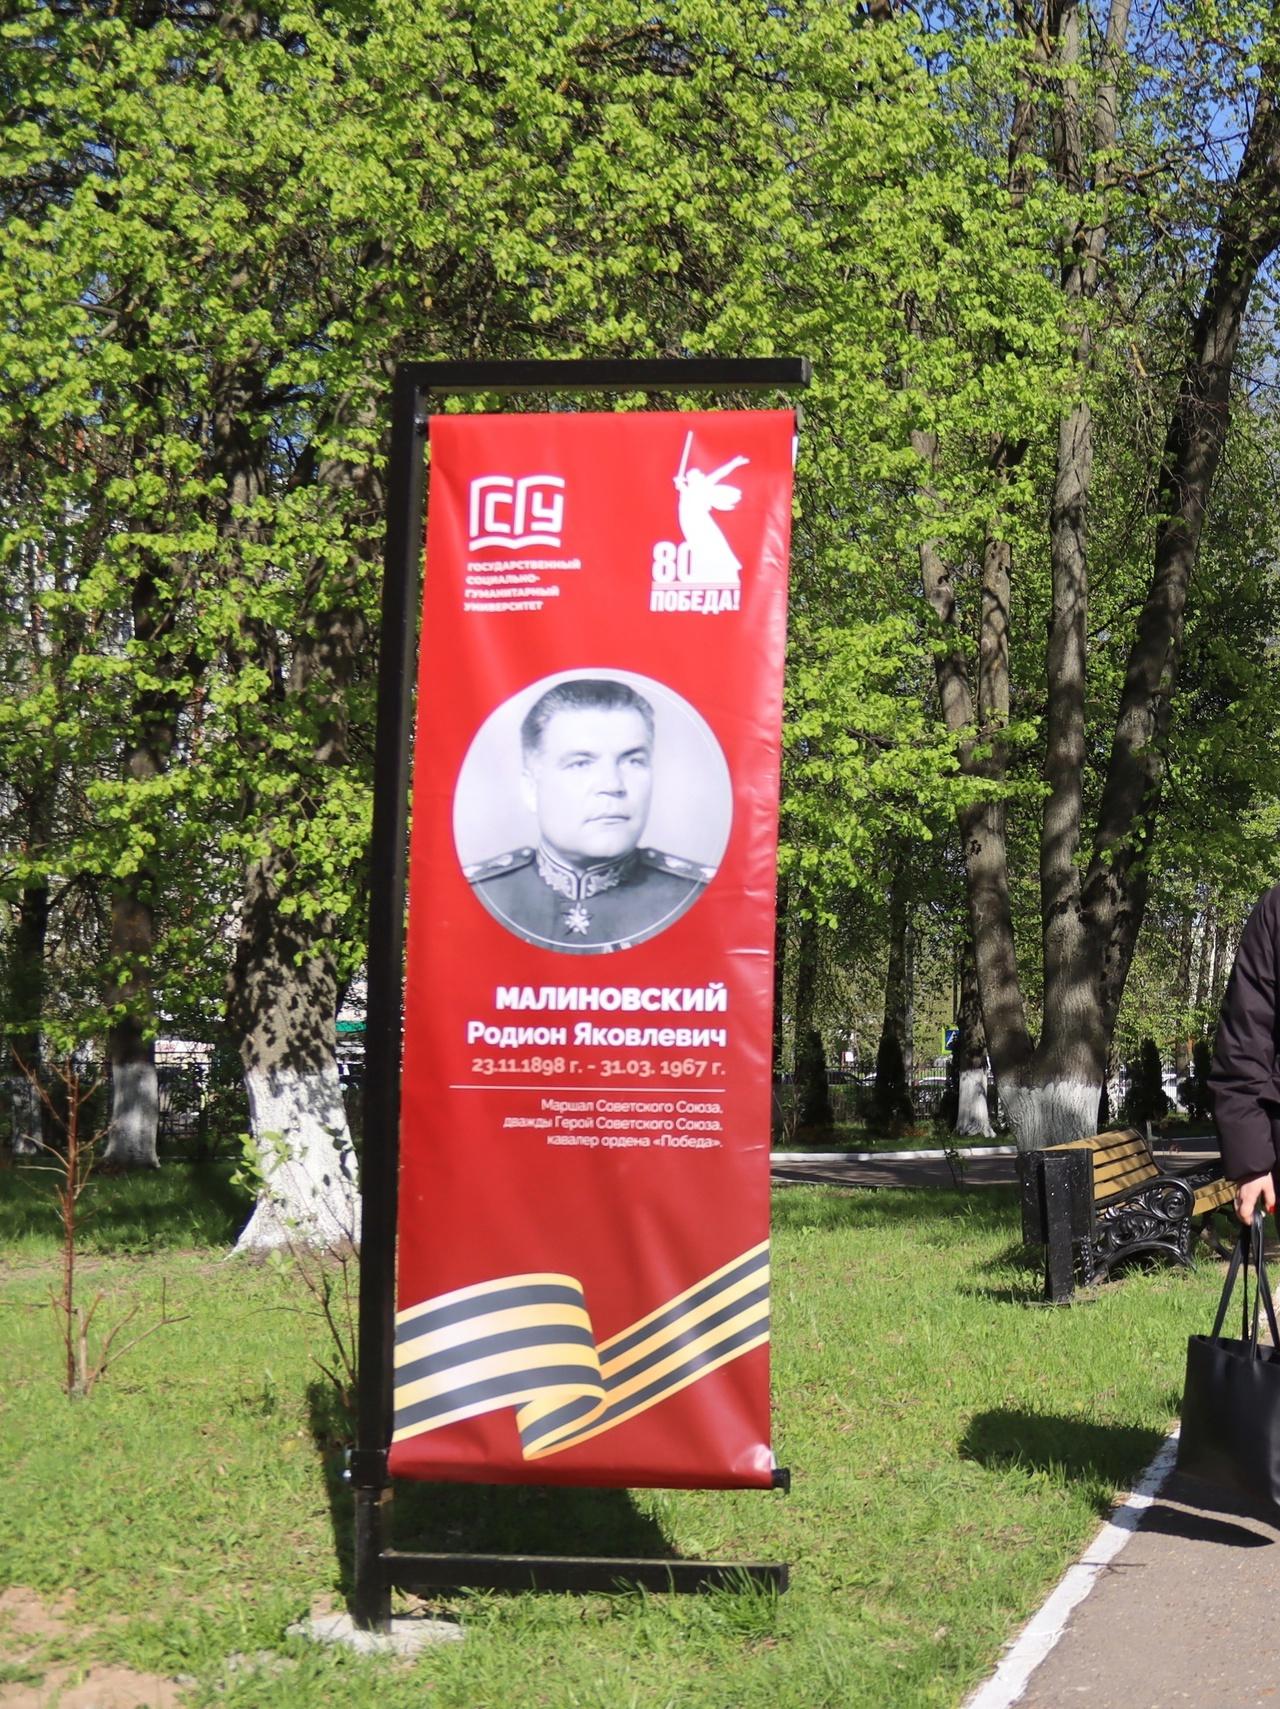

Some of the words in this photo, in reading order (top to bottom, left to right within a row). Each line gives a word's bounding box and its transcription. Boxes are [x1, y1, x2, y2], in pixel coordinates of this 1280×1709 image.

[467, 559, 581, 572] ГОСУДАРСТВЕННЫЙ
[652, 541, 696, 583] 80
[465, 574, 540, 586] СОЦИАЛЬНО-
[464, 585, 560, 598] ГУМАНИТАРНЫЙ
[464, 601, 543, 612] УНИВЕРСИТЕТ
[650, 590, 741, 615] ПОБЕДА!
[496, 983, 727, 1011] МАЛИНОВСКИЙ
[467, 1021, 566, 1048] Родион
[574, 1022, 727, 1047] Яковлевич
[472, 1057, 565, 1075] 23.11.1898
[570, 1060, 583, 1074] г.
[660, 1059, 707, 1077] 1967
[711, 1062, 726, 1075] г.
[541, 1098, 594, 1113] Маршал
[596, 1100, 673, 1114] Советского
[503, 1117, 552, 1128] дважды
[555, 1115, 594, 1130] Герой
[596, 1116, 673, 1131] Советского
[547, 1136, 599, 1147] кавалер
[601, 1136, 650, 1148] ордена
